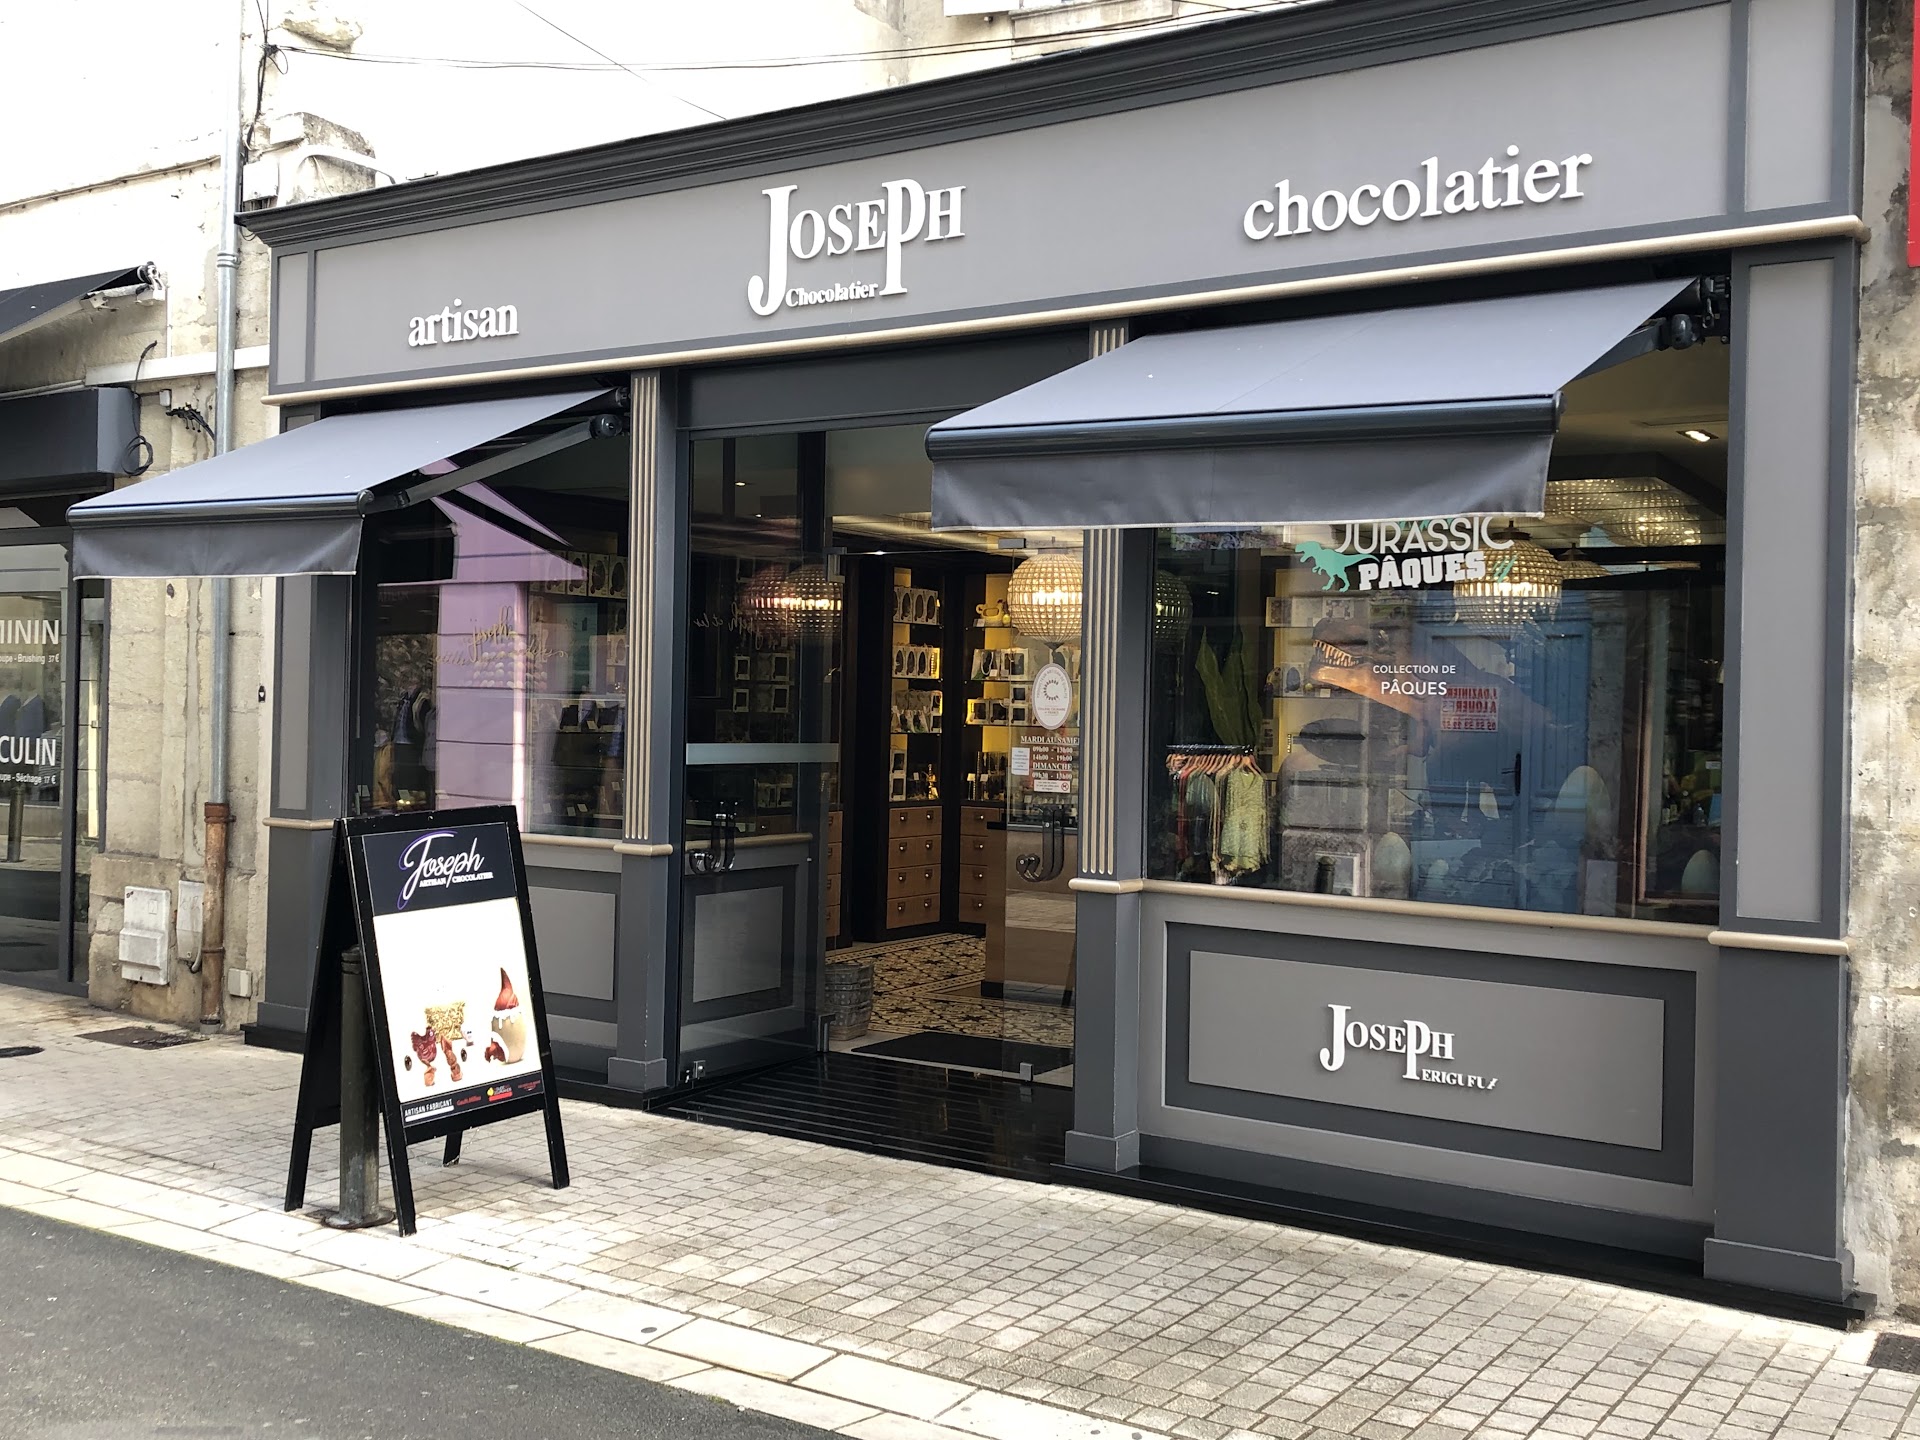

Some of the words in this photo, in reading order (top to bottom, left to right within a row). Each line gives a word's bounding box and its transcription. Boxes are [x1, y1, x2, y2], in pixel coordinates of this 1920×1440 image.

[1243, 144, 1593, 240] chocolatier
[747, 178, 966, 316] JOSEPH
[785, 281, 879, 307] Chocolatier
[408, 298, 519, 347] artisan
[1334, 516, 1515, 555] JURASSIC
[1358, 551, 1487, 591] PÂQUES
[0, 619, 60, 645] ININ
[17, 653, 46, 665] Brushing
[1373, 664, 1439, 674] COLLECTION
[1441, 664, 1456, 674] DE
[1381, 678, 1448, 696] PÂQUES
[0, 735, 56, 766] CULIN
[1020, 735, 1045, 744] MARDI
[1058, 736, 1080, 745] SAME
[15, 772, 42, 785] Séchage
[1032, 761, 1072, 770] DIMANCHE
[401, 832, 485, 902] Joseph
[451, 871, 494, 884] CHOCOLATIER
[1319, 1004, 1456, 1081] JOSEPH
[404, 1105, 426, 1117] ARTISAN
[426, 1098, 453, 1112] FABRICANT
